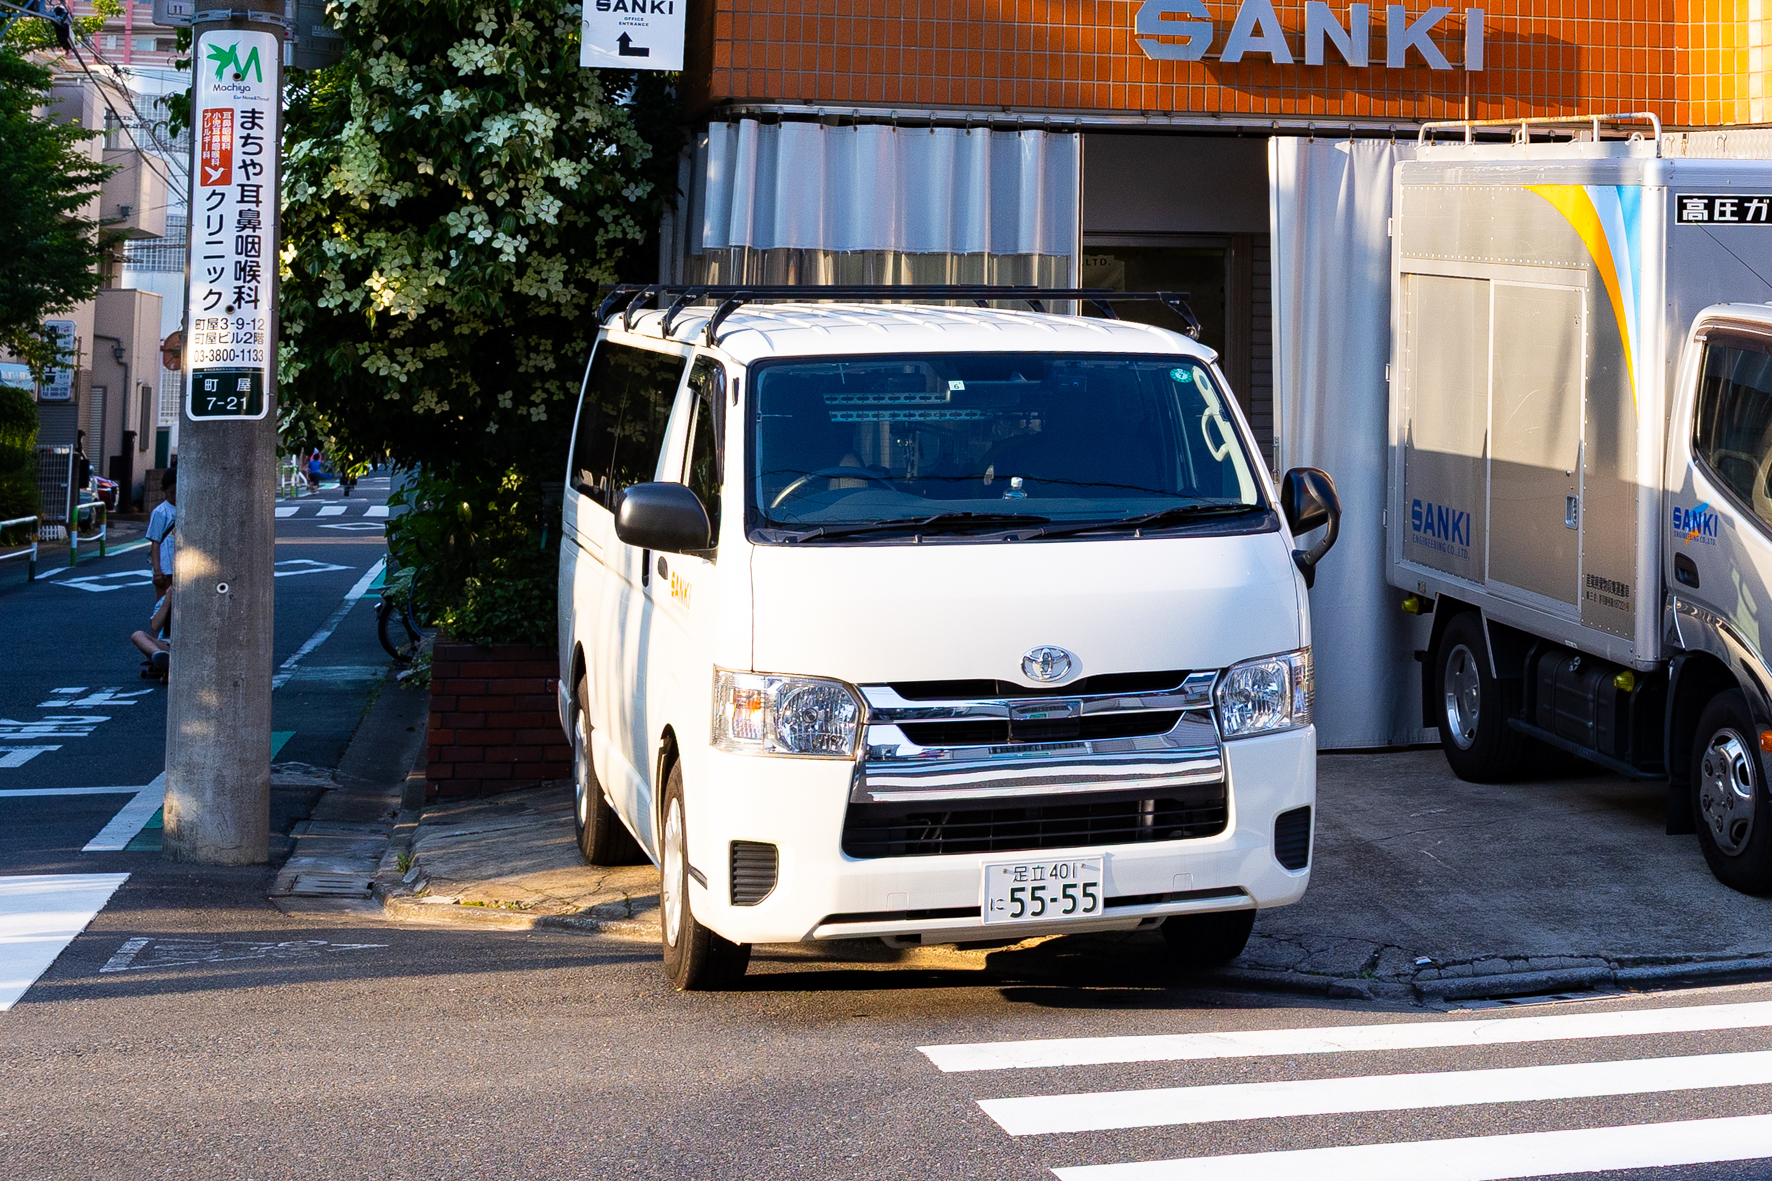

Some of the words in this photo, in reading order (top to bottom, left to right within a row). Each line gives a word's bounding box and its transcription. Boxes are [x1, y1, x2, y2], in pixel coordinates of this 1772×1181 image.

[212, 83, 251, 94] Machiya
[202, 112, 211, 160] アレルギー科
[232, 108, 265, 310] まちや耳鼻咽喉科
[202, 189, 226, 311] クリニック
[194, 317, 265, 331] 町屋3-9-12
[194, 332, 264, 345] 町屋ビル2階
[194, 348, 264, 362] 03-3800-1133
[206, 397, 247, 410] 7-21
[1412, 498, 1470, 547] SANKI
[1673, 506, 1718, 537] SANKI
[671, 571, 692, 610] SANKI
[1013, 865, 1045, 882] 足立
[1049, 862, 1076, 880] 401
[990, 898, 1004, 911] に
[1009, 882, 1098, 918] 55-55
